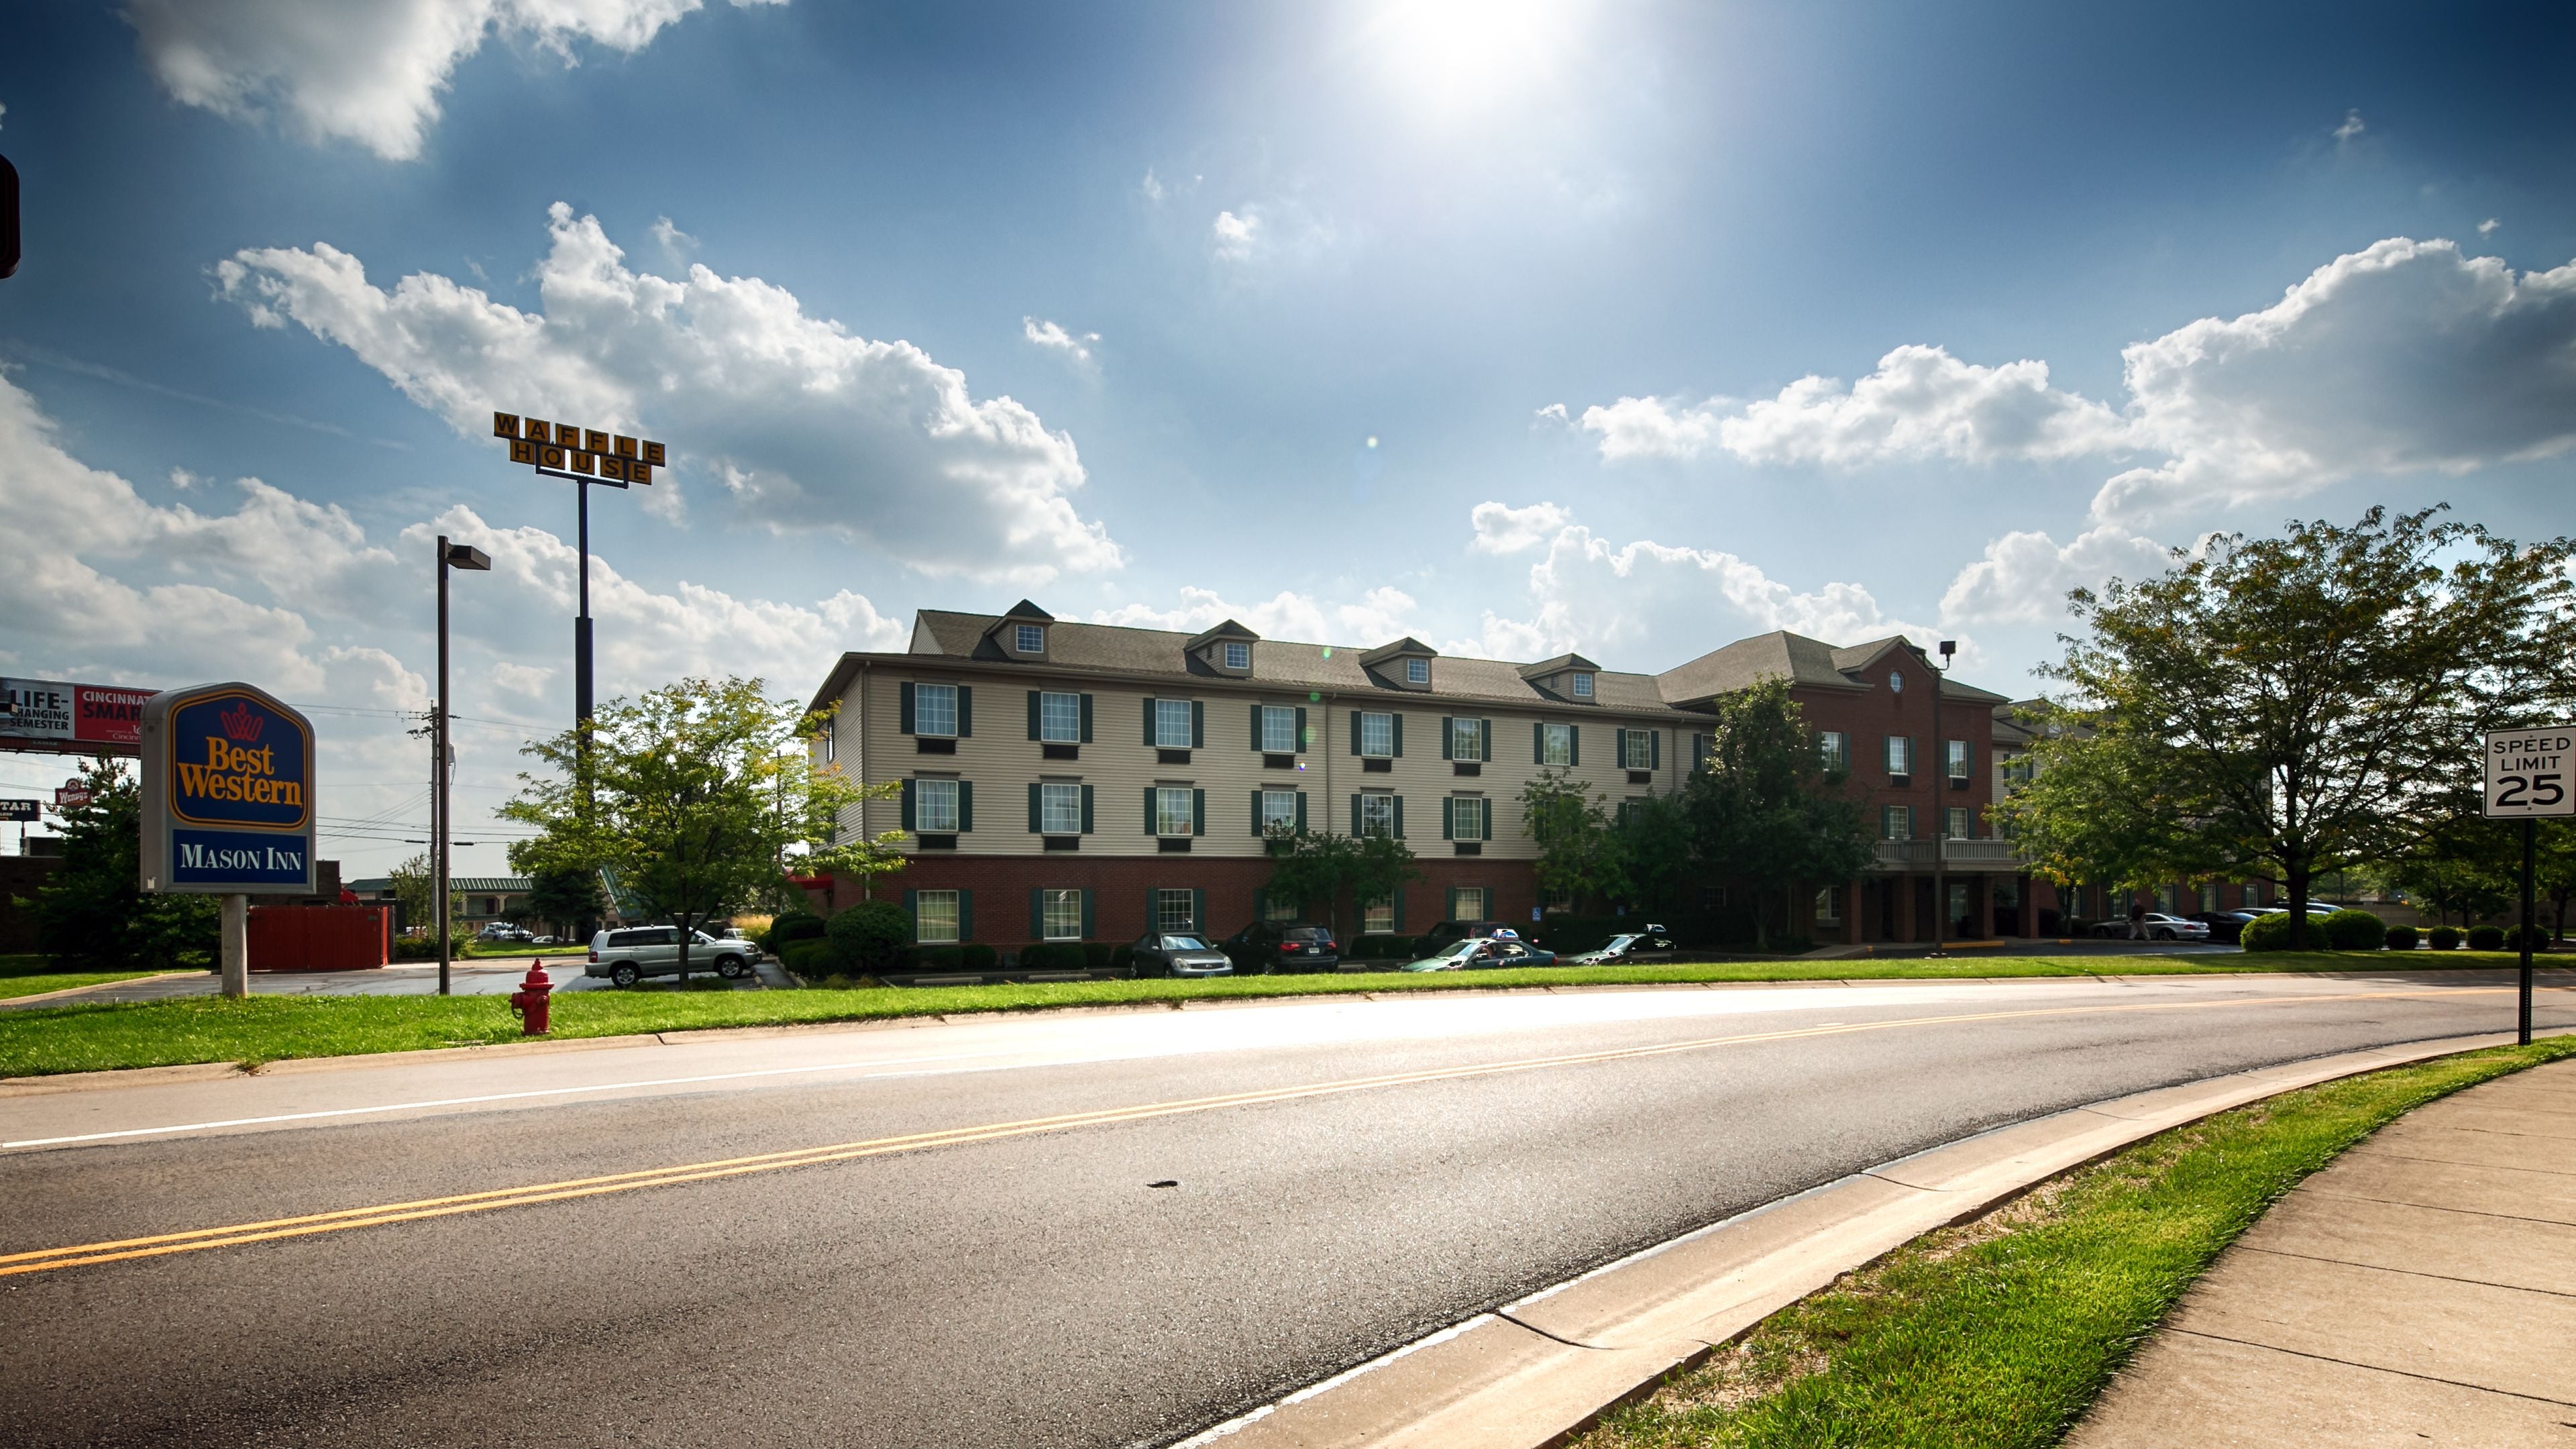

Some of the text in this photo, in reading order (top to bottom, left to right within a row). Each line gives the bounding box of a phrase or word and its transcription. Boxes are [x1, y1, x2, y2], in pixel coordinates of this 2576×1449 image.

[496, 415, 661, 460] WAFFLE
[515, 443, 647, 481] HOUSE
[10, 689, 69, 710] LIFE-
[83, 703, 140, 722] SMAR
[9, 718, 69, 731] SEMESTER
[112, 733, 141, 741] Cincinn
[2493, 737, 2571, 754] SPEED
[205, 736, 275, 775] Best
[2501, 755, 2561, 771] LIMIT
[177, 762, 302, 806] Western
[2496, 773, 2564, 807] 25
[0, 802, 32, 811] TAR
[180, 843, 302, 871] MASON INN
